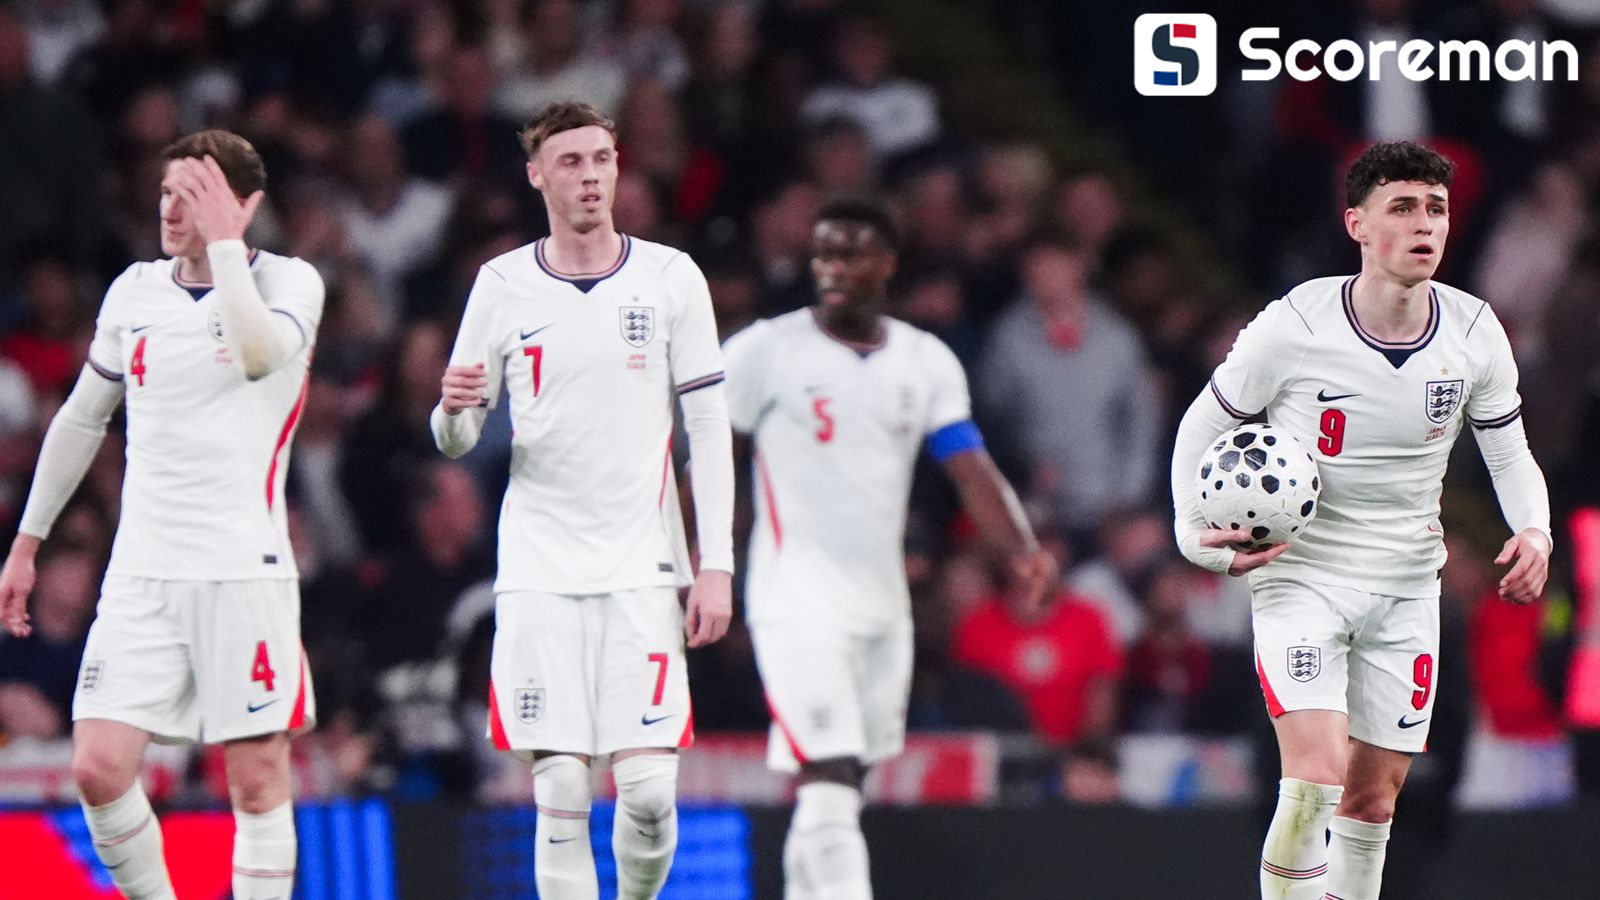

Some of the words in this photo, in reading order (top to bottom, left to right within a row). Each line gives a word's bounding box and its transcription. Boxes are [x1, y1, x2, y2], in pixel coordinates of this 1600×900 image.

[130, 336, 147, 385] 4
[523, 345, 544, 396] 7
[813, 397, 834, 443] 5
[1317, 408, 1346, 457] 9
[250, 640, 276, 692] 4
[648, 653, 669, 706] 7
[1411, 653, 1434, 711] 9
